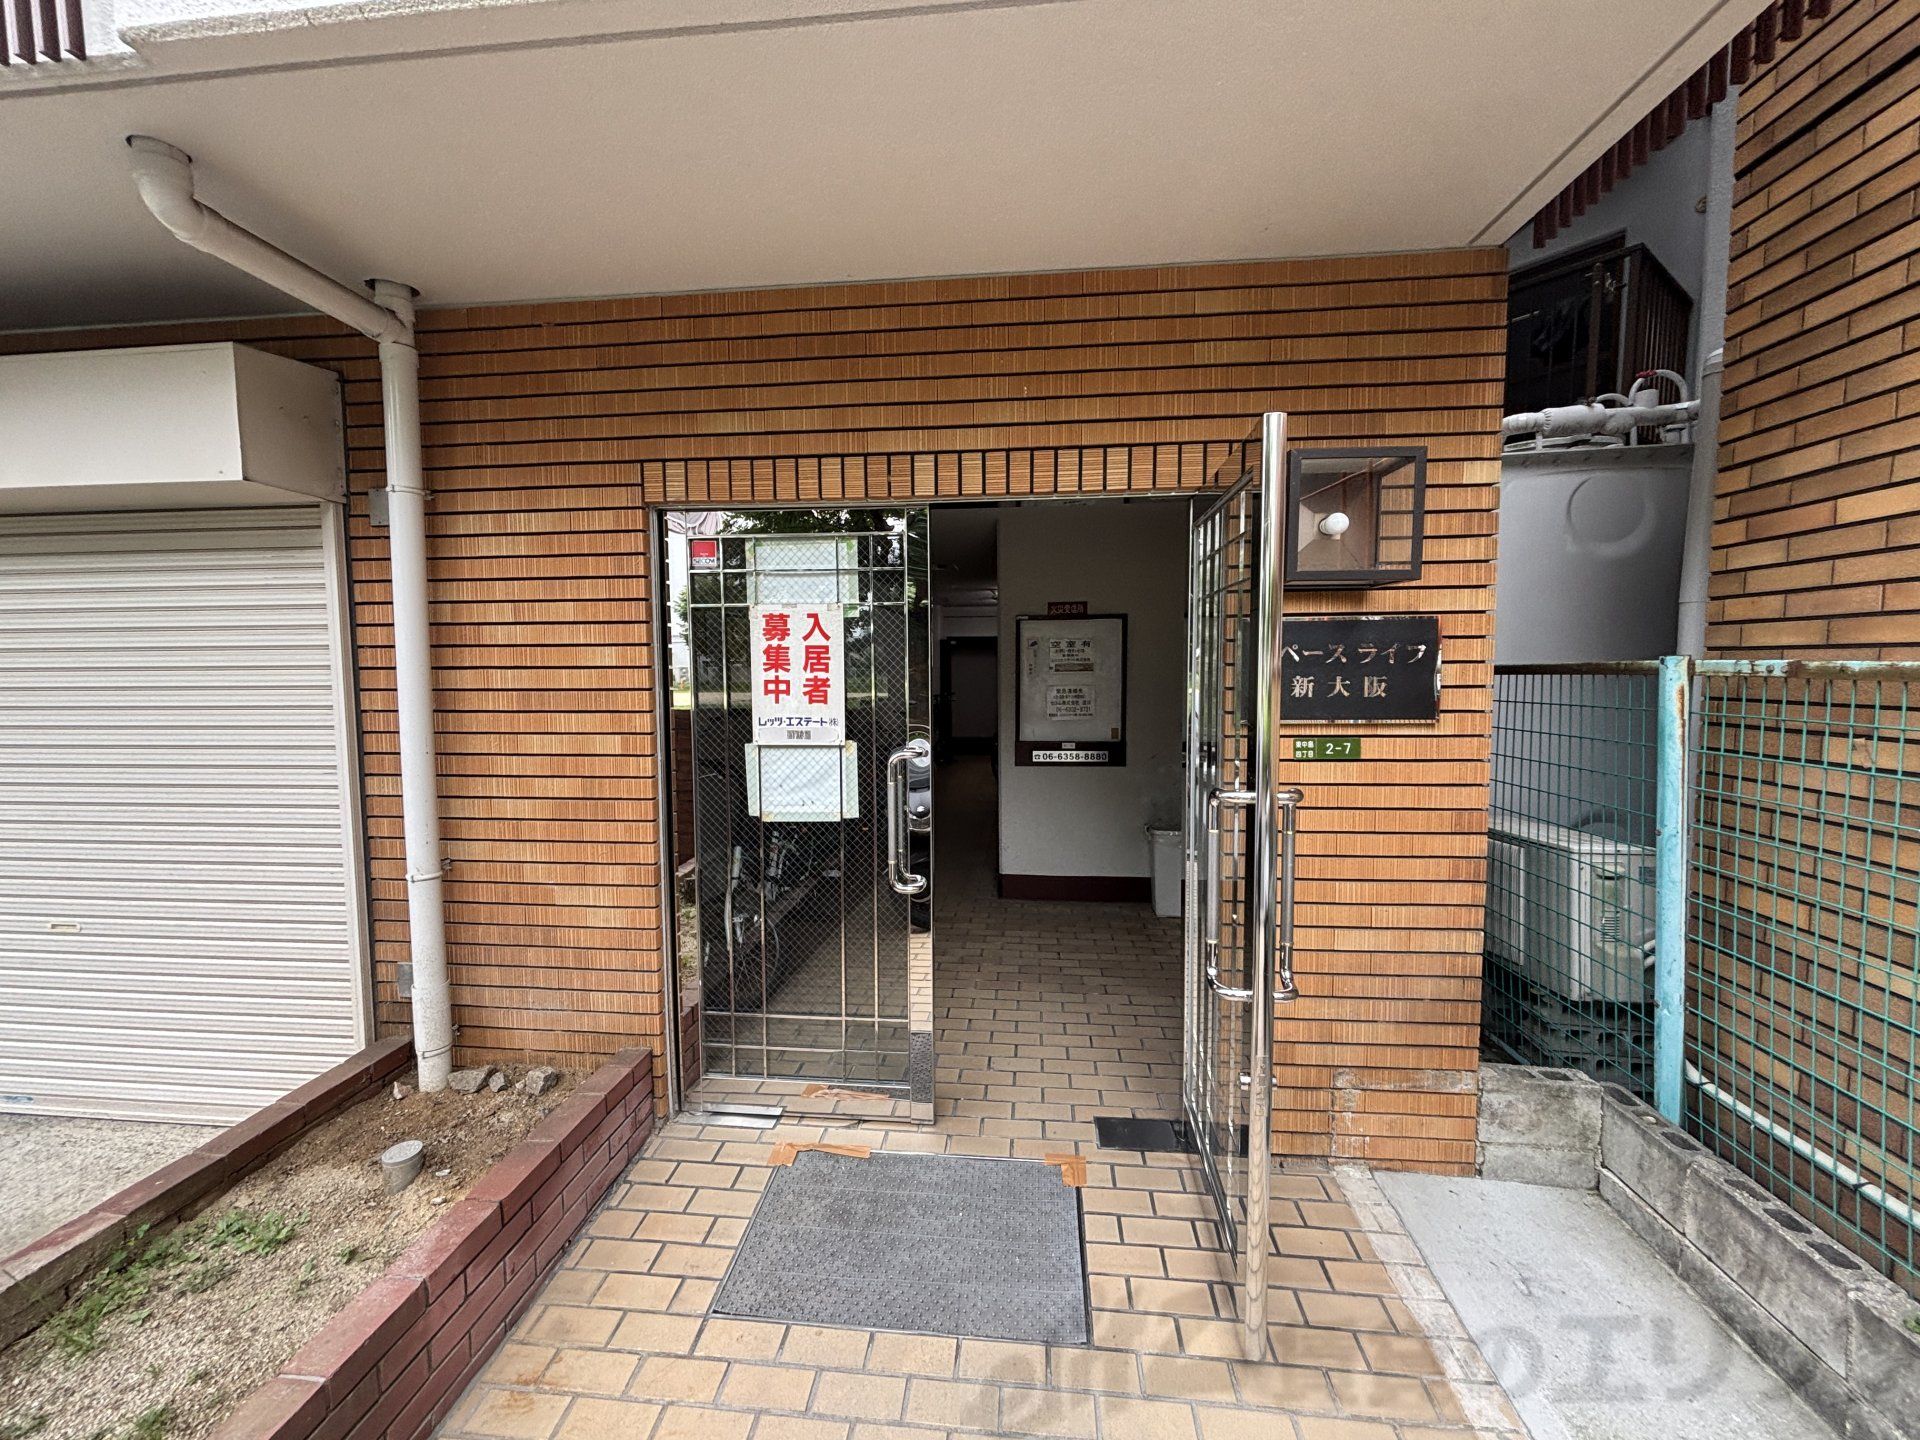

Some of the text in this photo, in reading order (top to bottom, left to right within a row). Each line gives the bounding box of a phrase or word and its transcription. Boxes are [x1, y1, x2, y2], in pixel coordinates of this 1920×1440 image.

[762, 612, 791, 704] 募集中
[802, 612, 831, 706] 入居者
[1290, 675, 1388, 698] 新大阪
[1042, 752, 1107, 761] 06-6358-8880
[1325, 742, 1352, 755] 2-7
